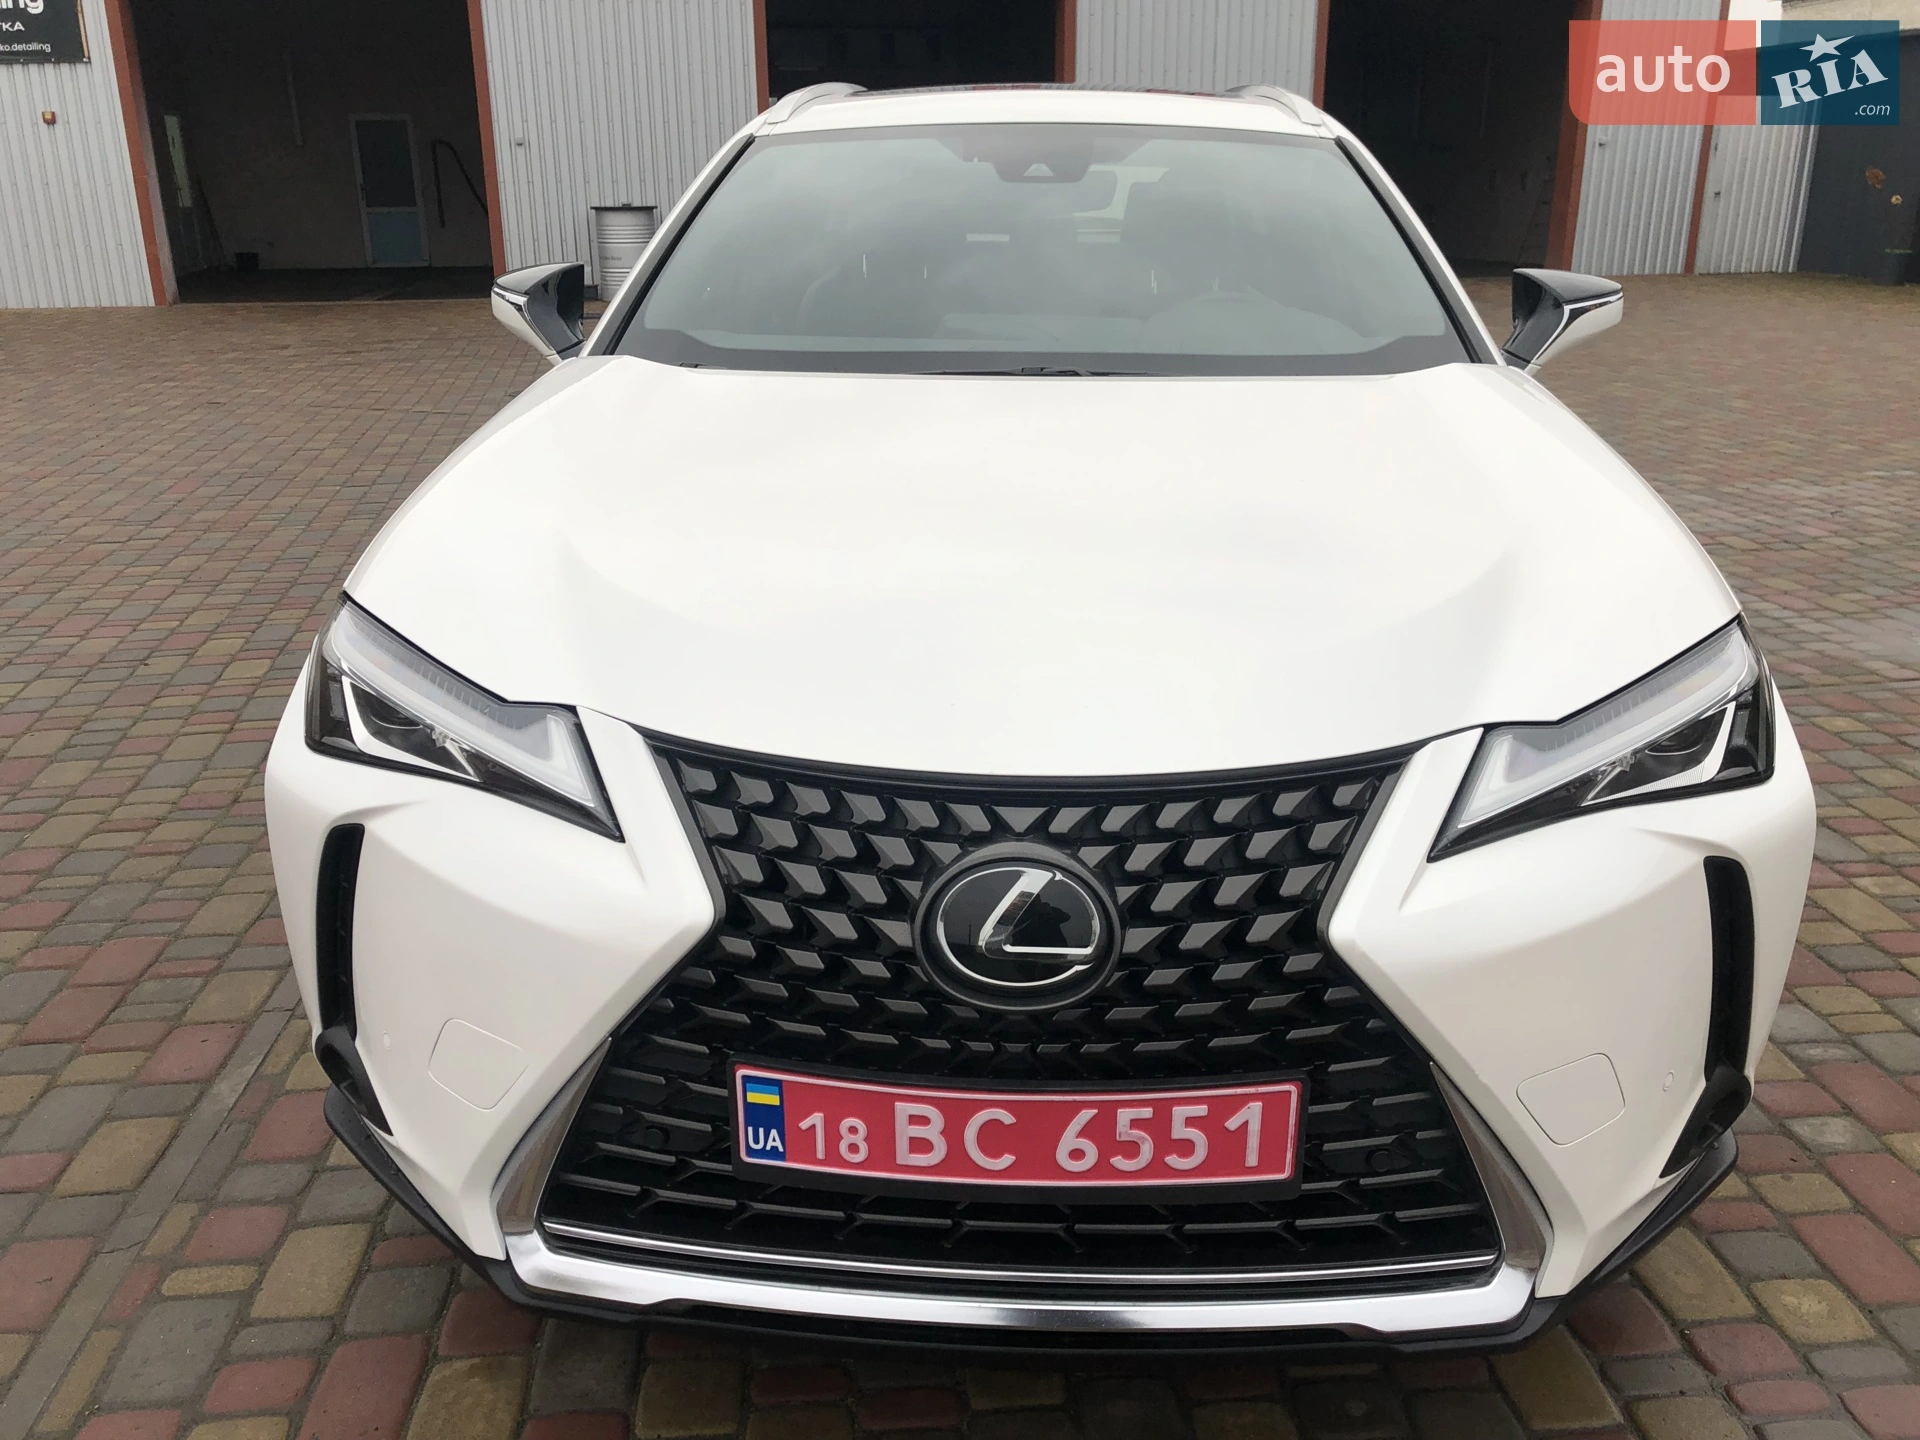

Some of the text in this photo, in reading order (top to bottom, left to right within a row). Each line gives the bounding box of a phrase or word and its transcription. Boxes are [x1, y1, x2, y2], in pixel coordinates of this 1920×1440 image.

[747, 1126, 784, 1152] UA
[798, 1101, 1263, 1173] 18 BC 6551
